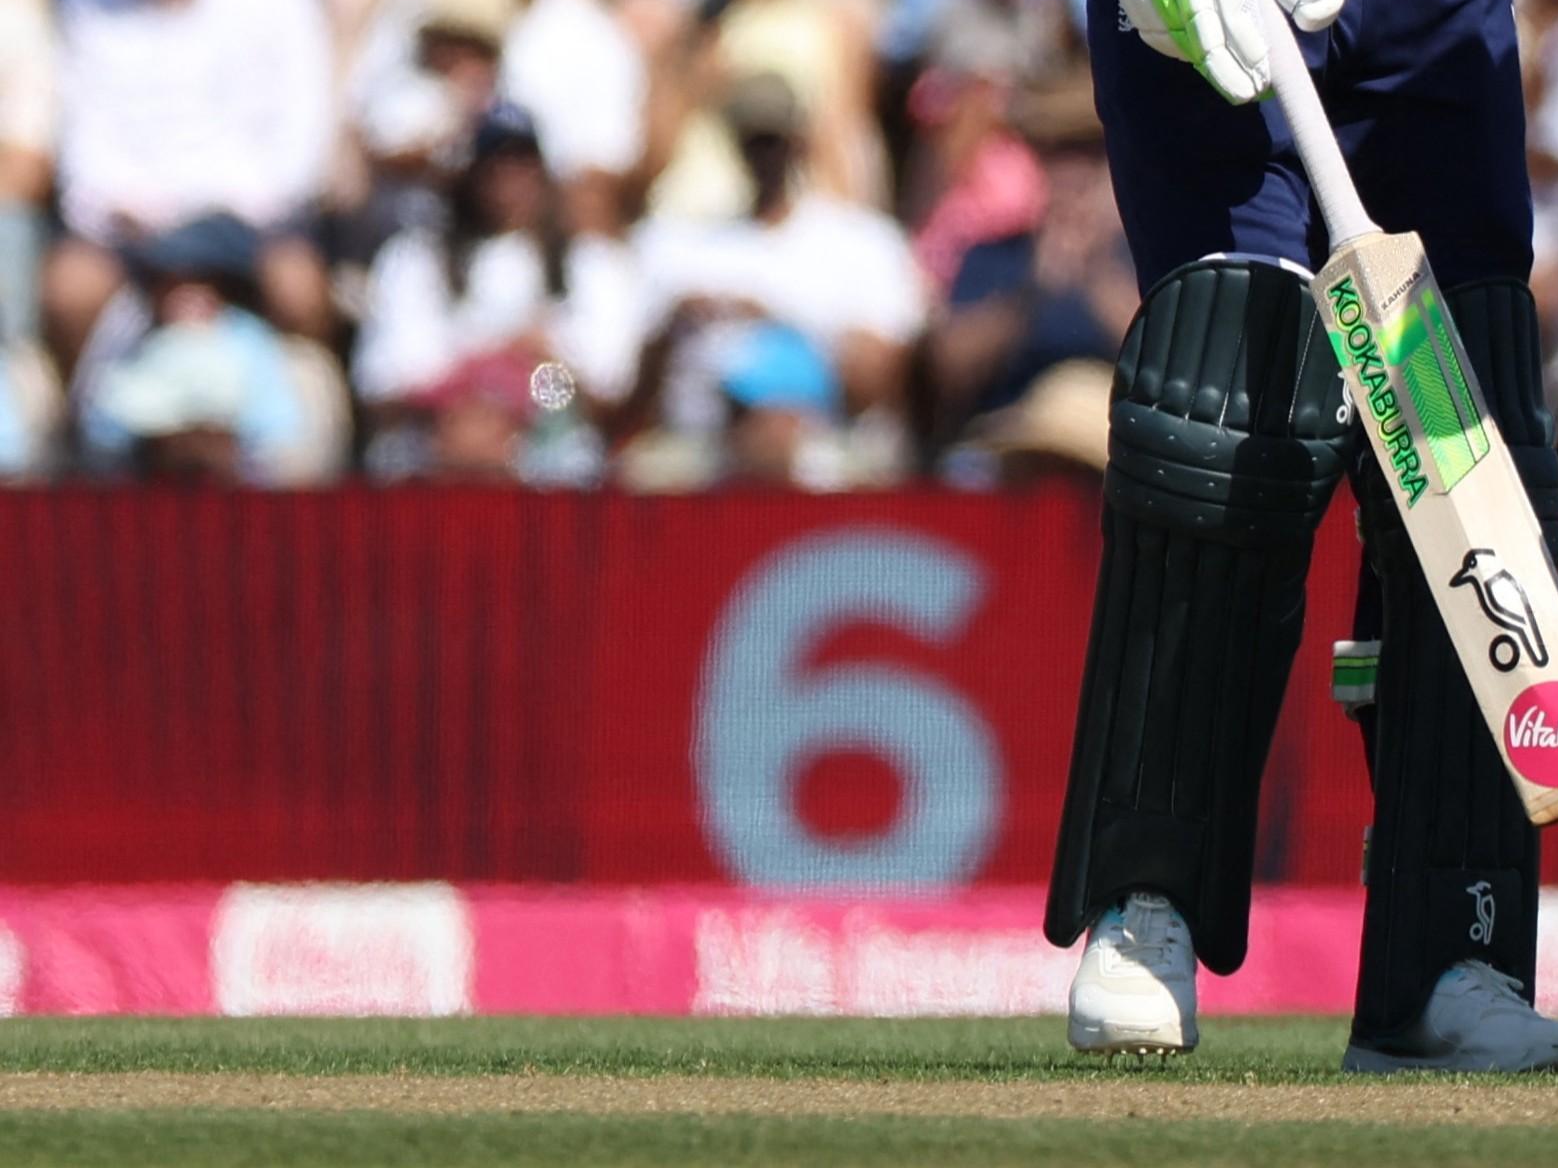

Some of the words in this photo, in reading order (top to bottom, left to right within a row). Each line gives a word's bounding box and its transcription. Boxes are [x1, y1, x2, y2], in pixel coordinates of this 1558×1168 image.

[1328, 277, 1429, 509] KOOKABURRA
[1381, 272, 1420, 311] KAHUNA
[692, 524, 1003, 894] 6
